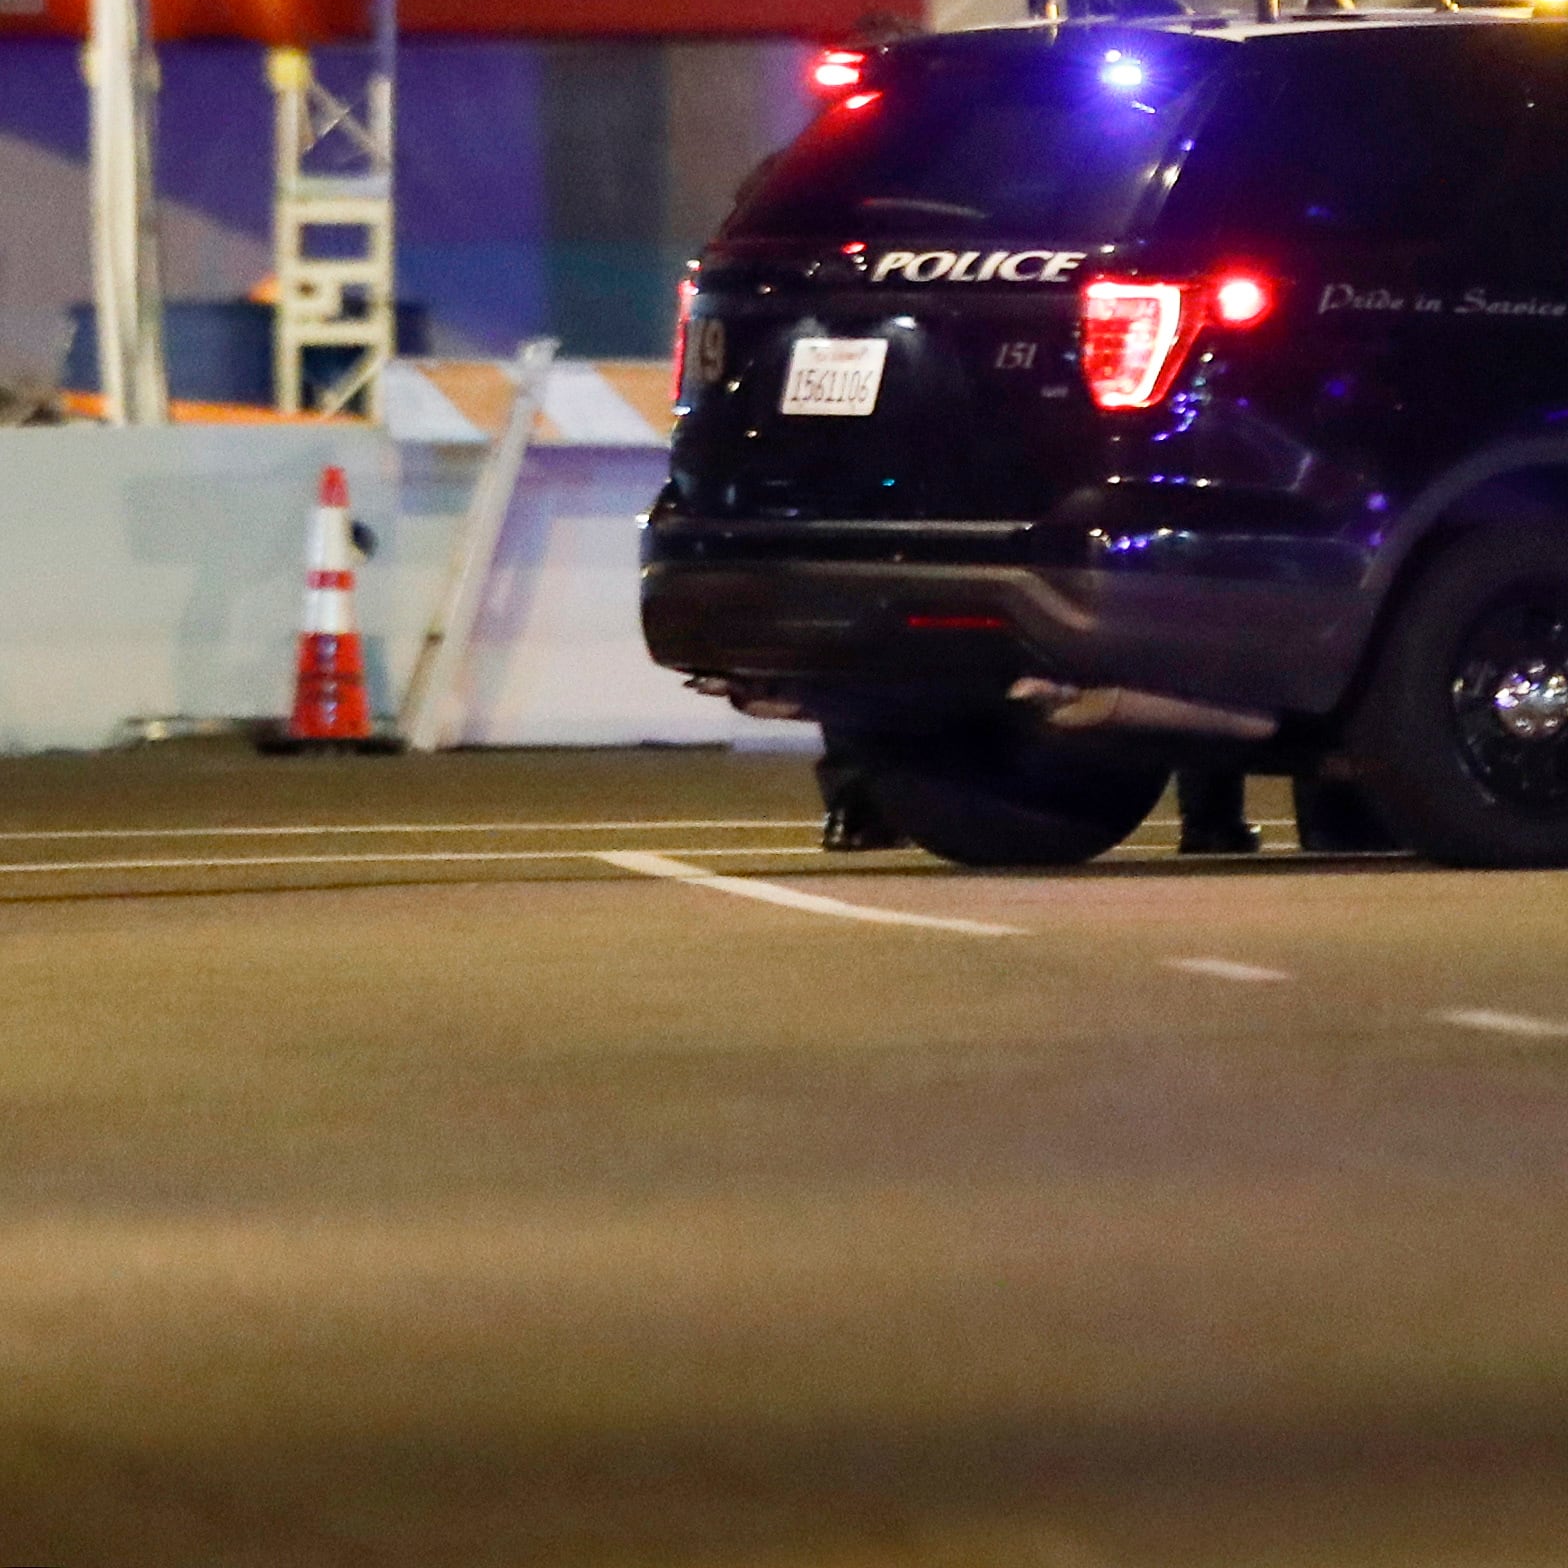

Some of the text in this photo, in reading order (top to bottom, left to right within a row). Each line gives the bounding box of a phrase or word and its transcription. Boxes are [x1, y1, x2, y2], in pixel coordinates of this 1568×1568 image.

[871, 250, 1088, 283] POLICE
[1317, 282, 1568, 317] Pride in Service
[993, 340, 1039, 371] 151
